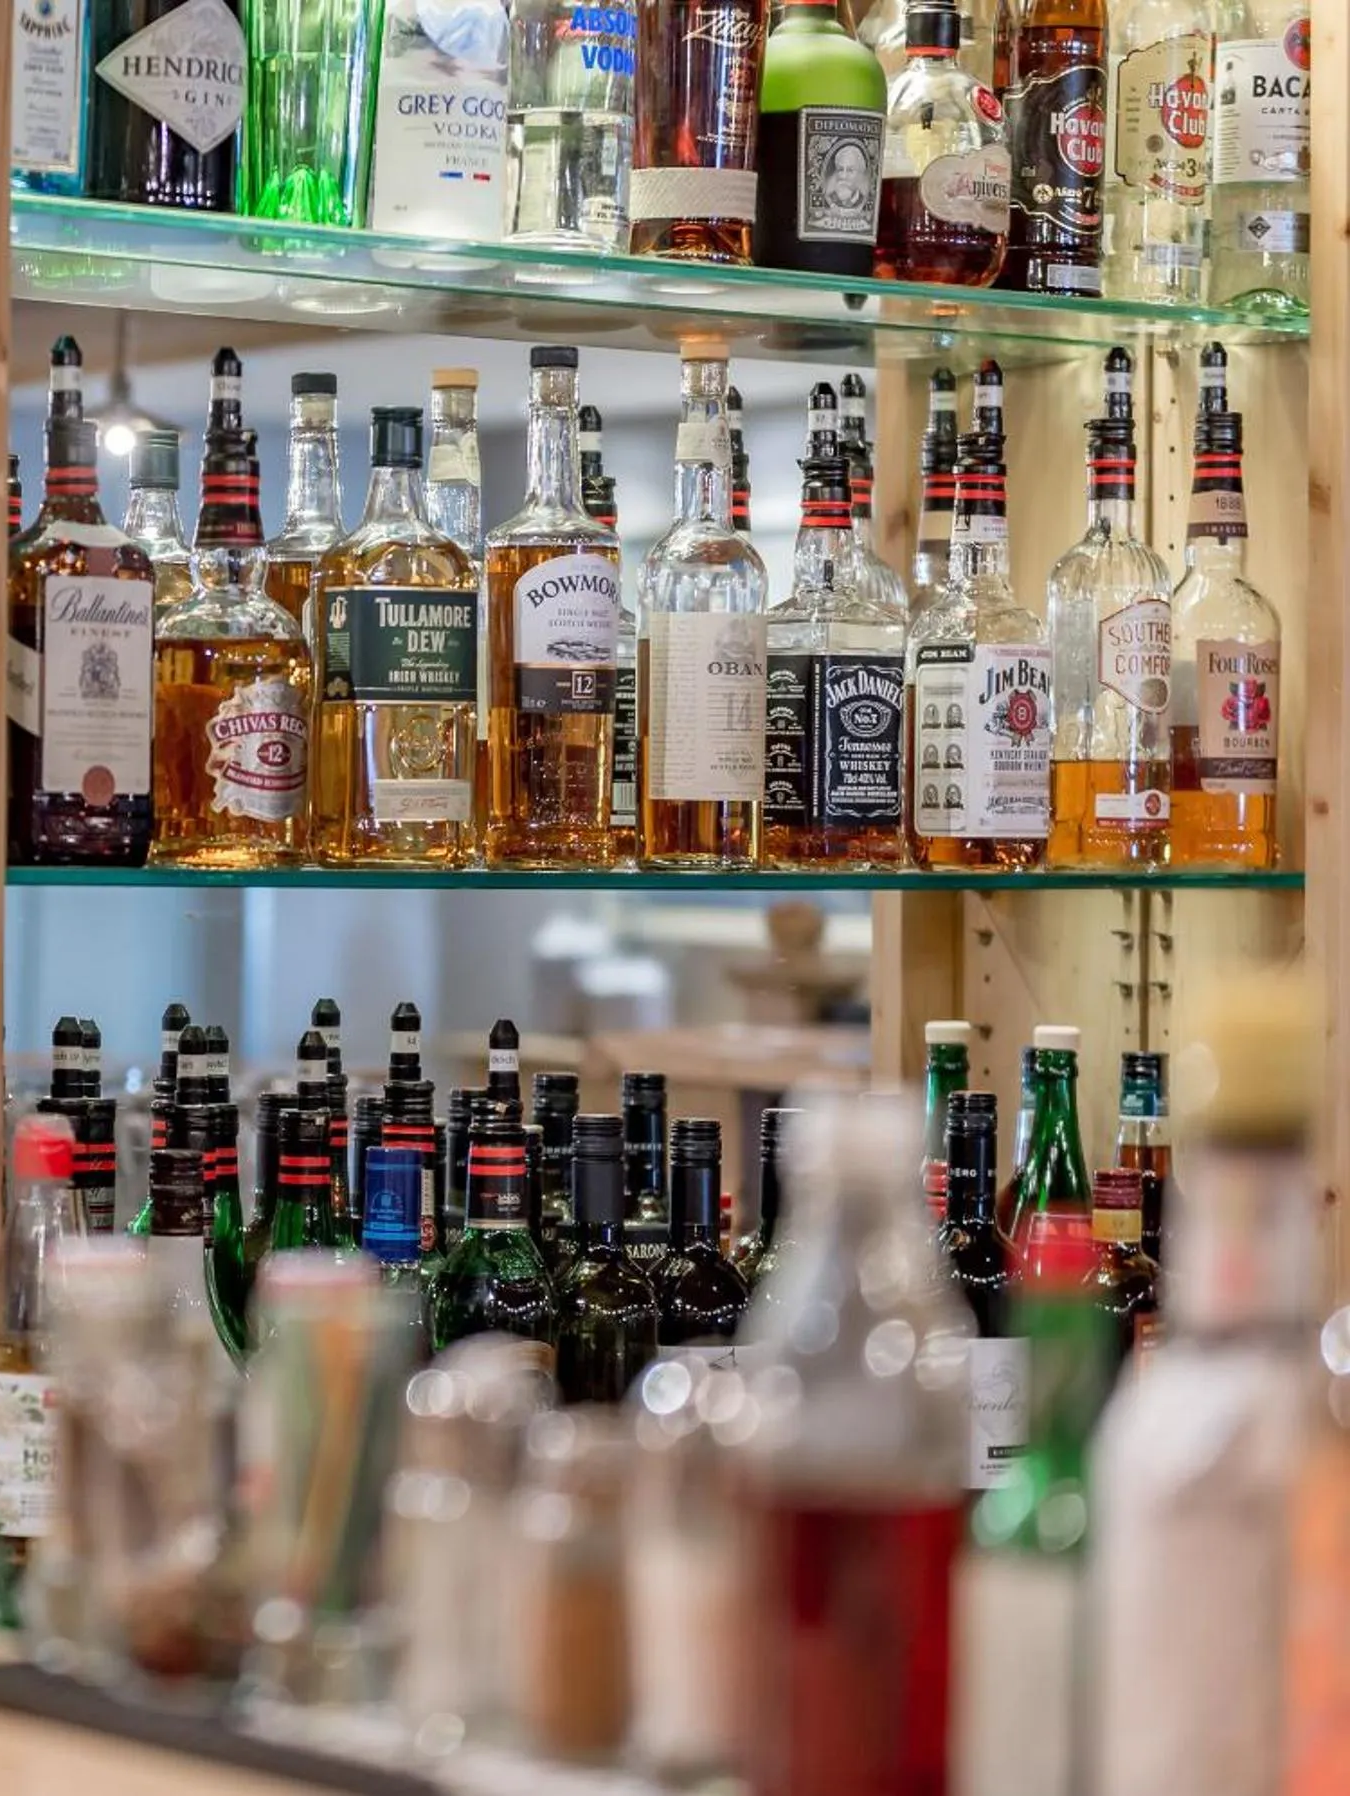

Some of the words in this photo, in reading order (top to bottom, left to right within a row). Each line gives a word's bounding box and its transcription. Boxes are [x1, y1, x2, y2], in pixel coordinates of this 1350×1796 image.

[185, 90, 225, 107] GIN
[398, 94, 455, 115] GREY
[462, 96, 507, 121] GOO
[433, 121, 498, 142] VODKA
[1186, 158, 1197, 178] 3
[374, 597, 472, 628] TULLAMORE
[707, 661, 763, 676] OBAN
[575, 676, 593, 694] 12
[825, 677, 858, 708] JACK
[979, 666, 1014, 704] JIM
[215, 714, 277, 739] CHIVAS
[269, 744, 284, 762] 12
[839, 760, 892, 772] WHISKEY
